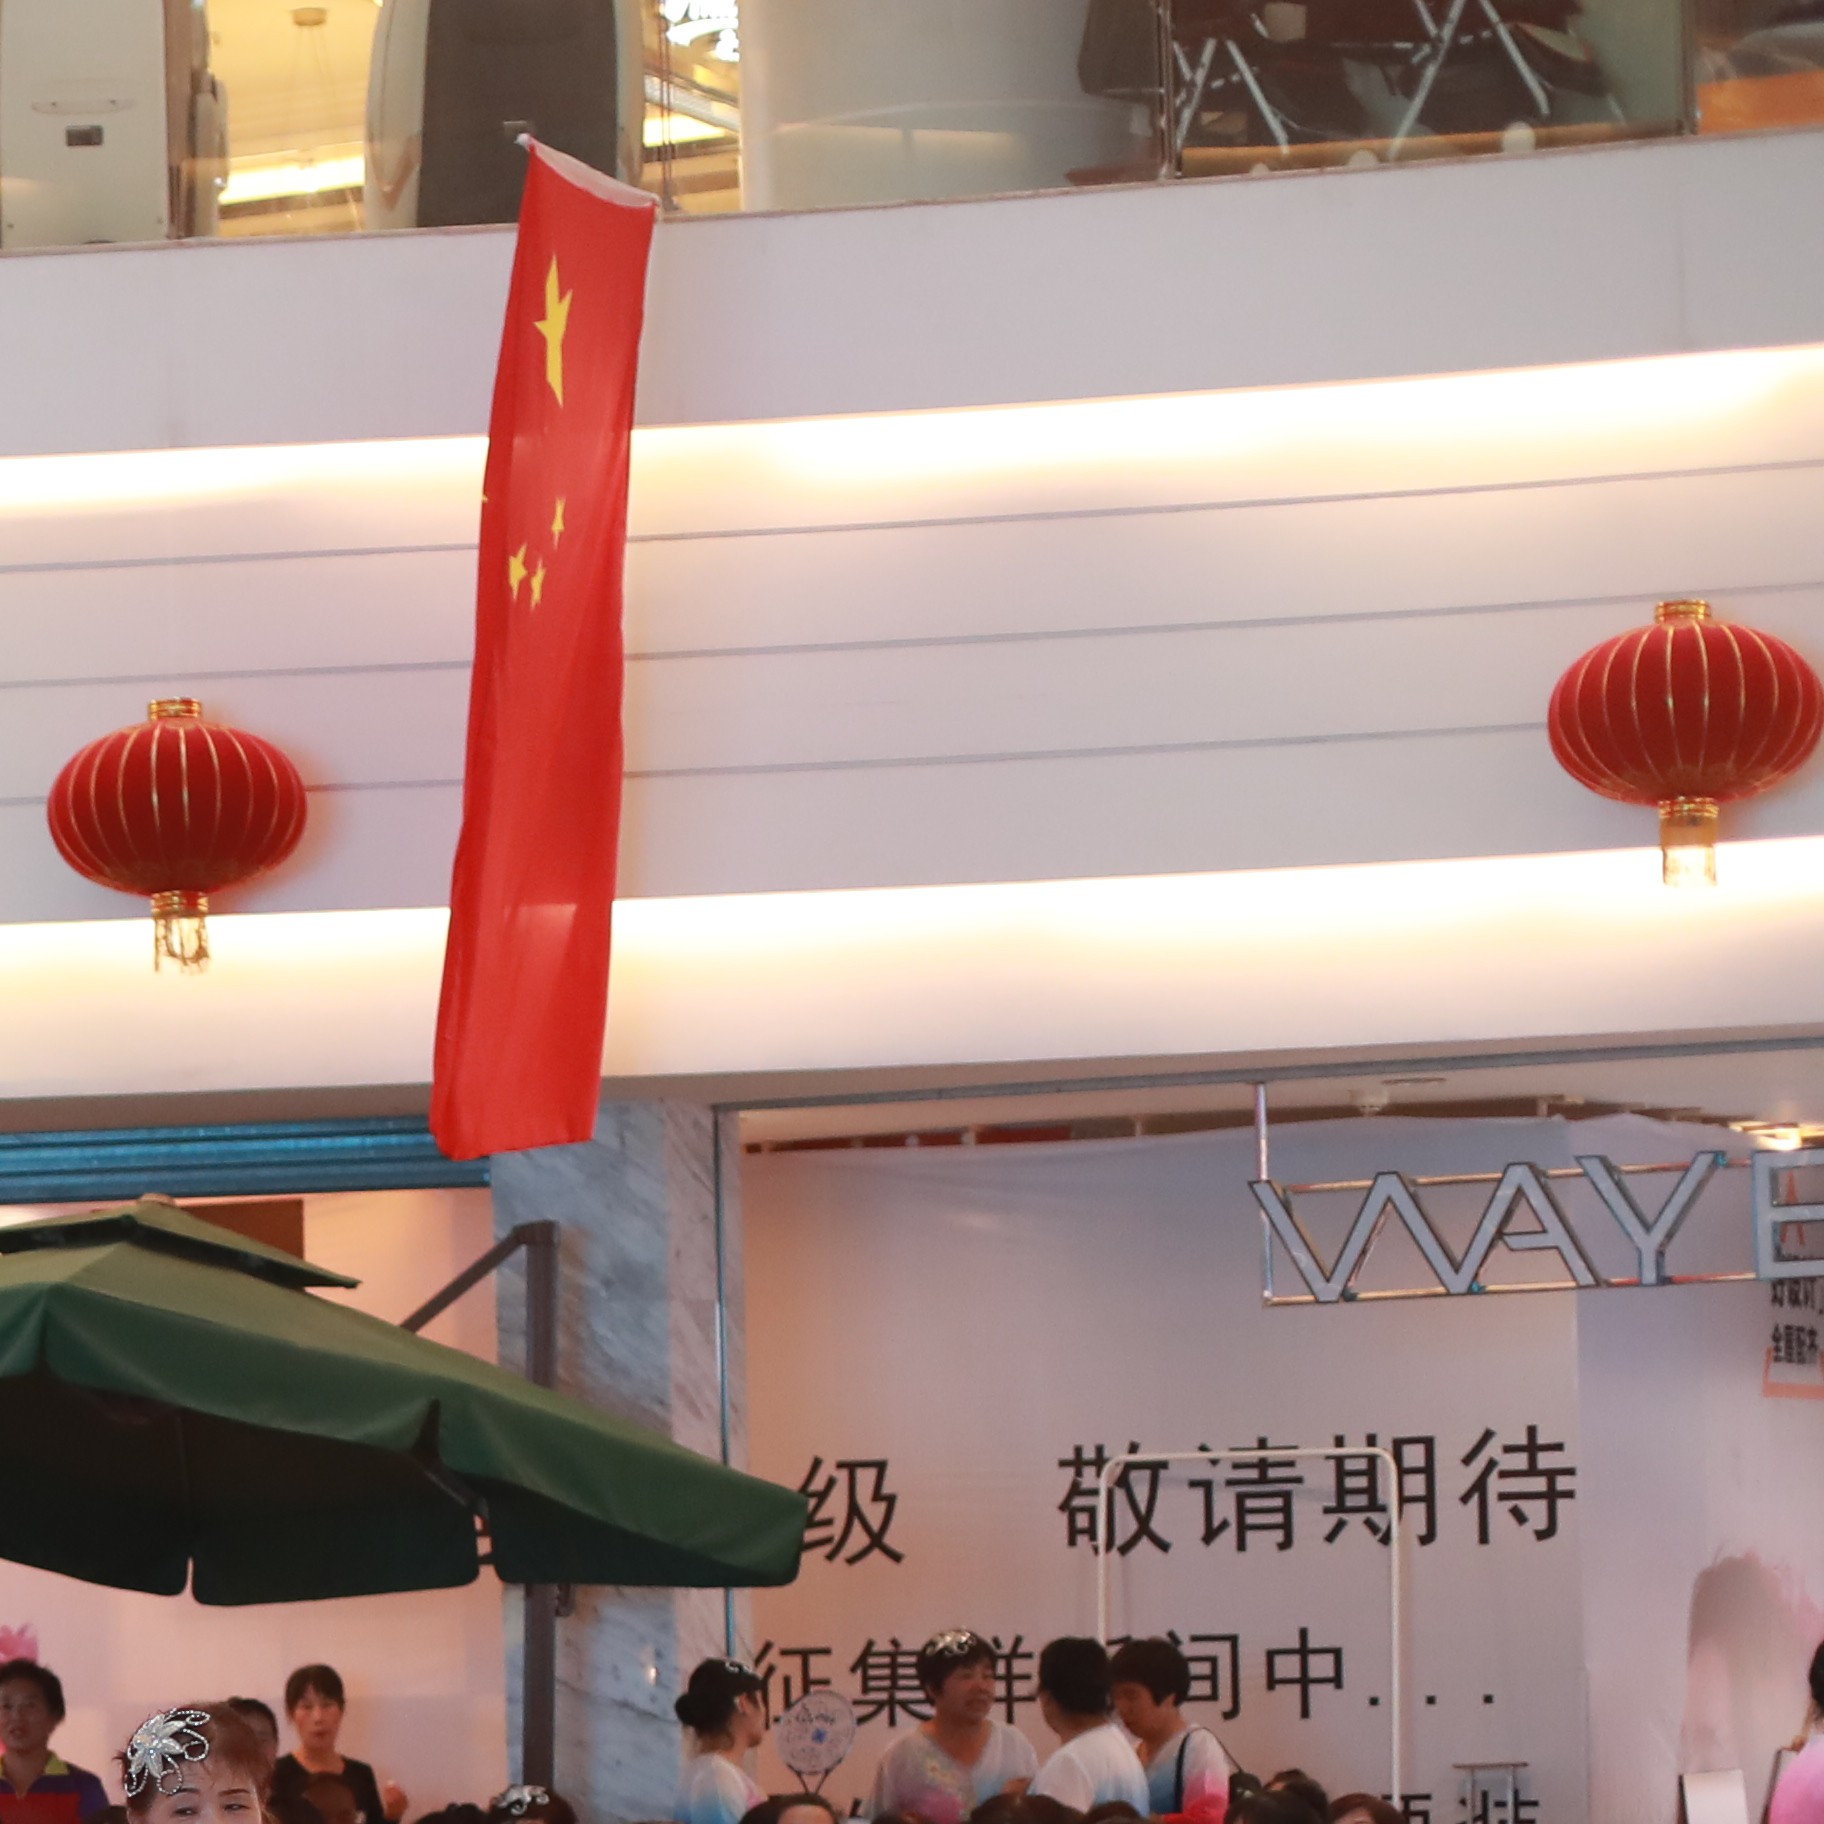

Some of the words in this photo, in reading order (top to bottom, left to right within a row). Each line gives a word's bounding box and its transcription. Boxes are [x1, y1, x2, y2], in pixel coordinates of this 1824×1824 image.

[1248, 1150, 1727, 1302] WAY
[1057, 1424, 1579, 1558] 敬请期待
